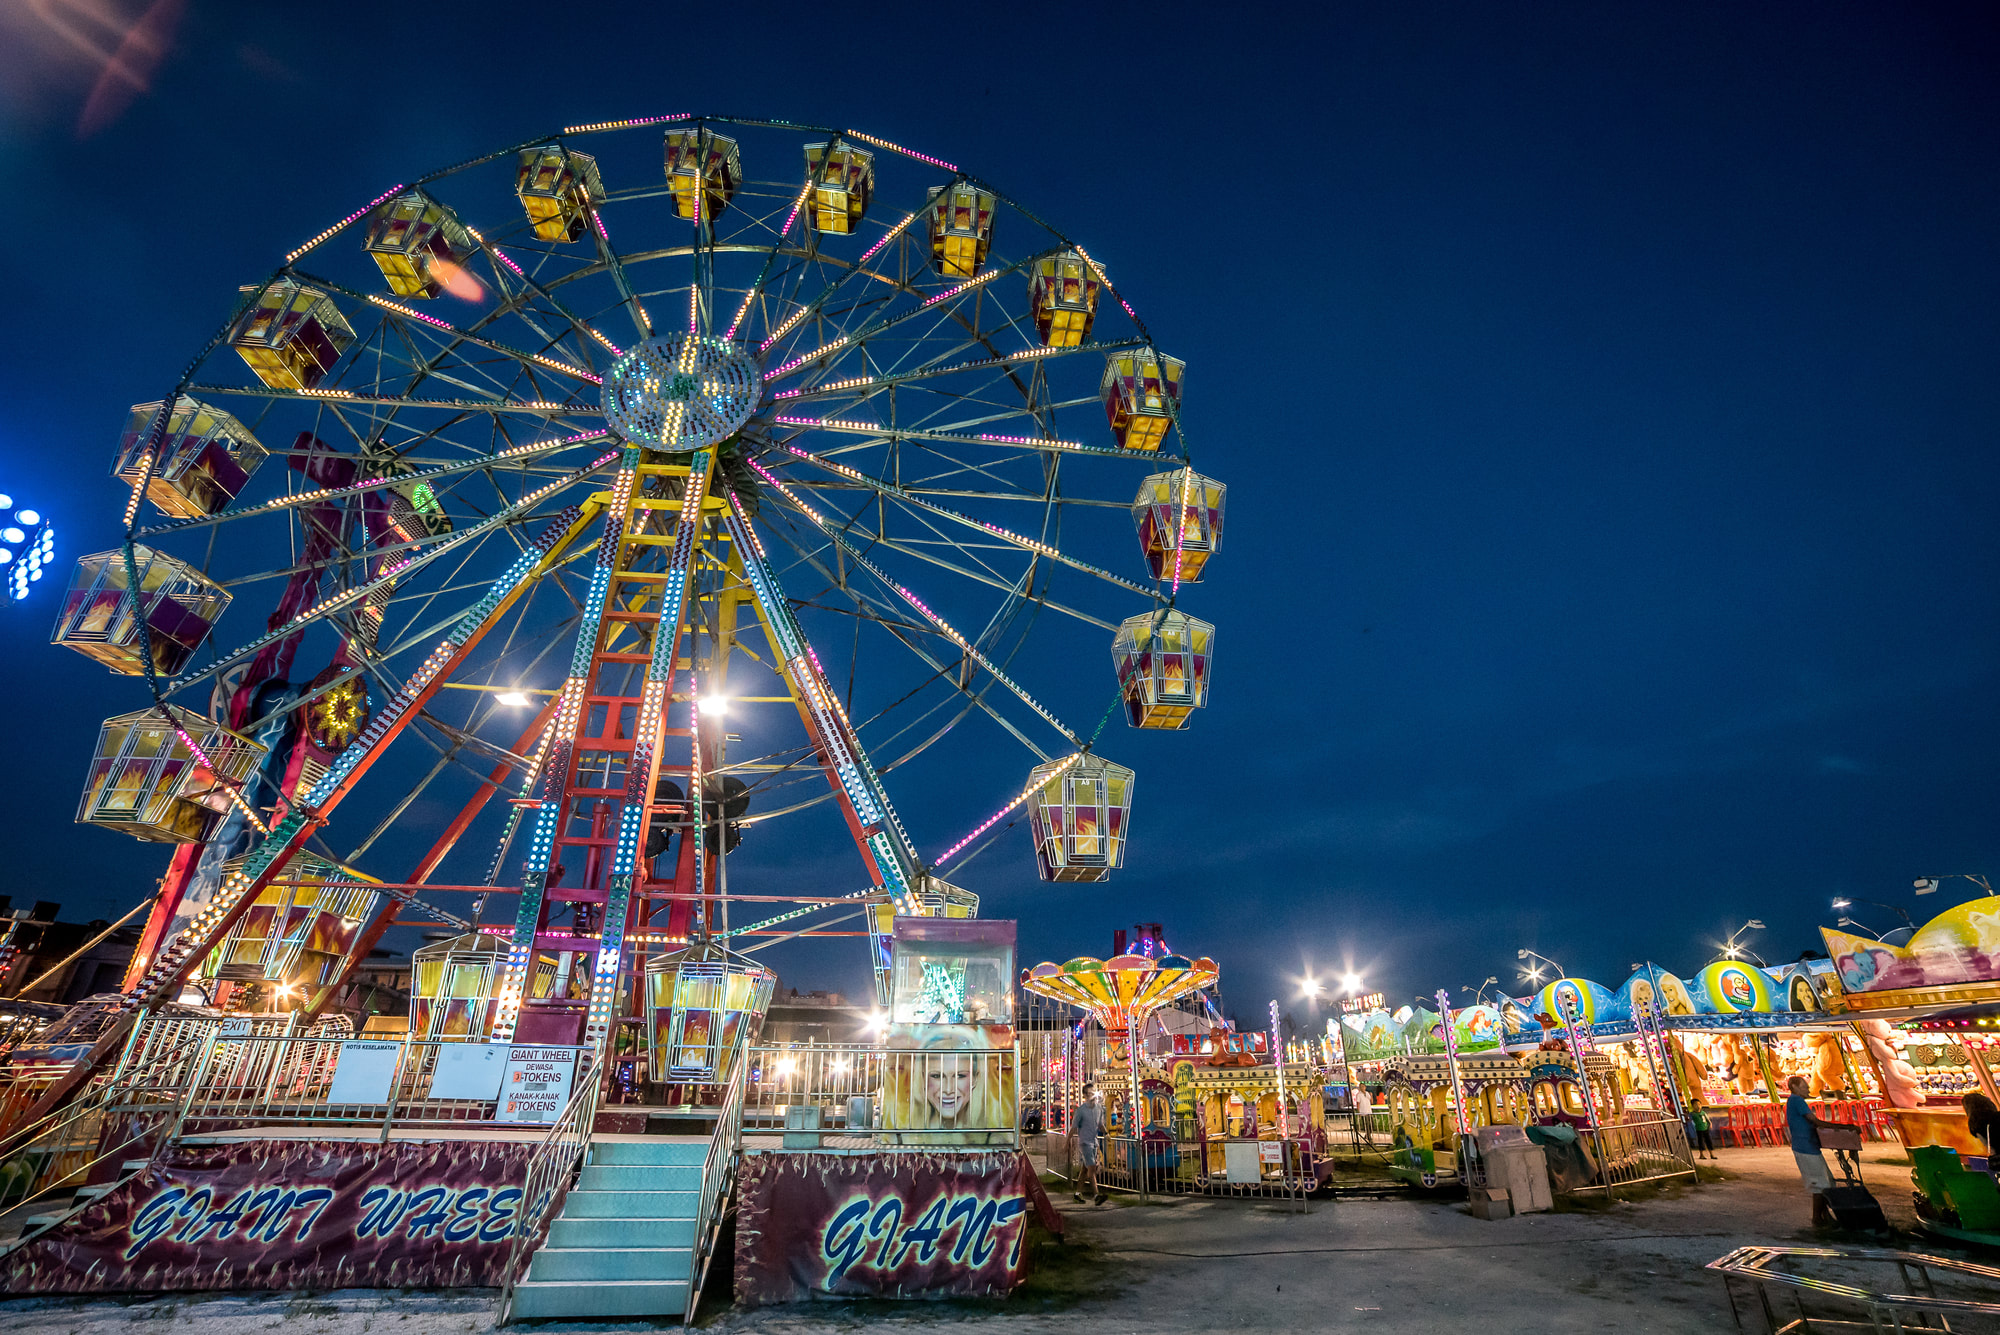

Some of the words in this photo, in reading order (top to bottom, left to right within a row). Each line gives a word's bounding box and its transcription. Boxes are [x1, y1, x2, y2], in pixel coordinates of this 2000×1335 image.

[222, 1020, 250, 1031] EXIT
[1184, 1033, 1256, 1053] TEN
[511, 1049, 540, 1060] GIANT
[541, 1050, 572, 1060] WHEEL
[525, 1063, 554, 1071] DEWASA
[509, 1092, 560, 1100] KANAK-KANAK
[124, 1187, 334, 1260] GIANT
[824, 1196, 1026, 1290] GIANT
